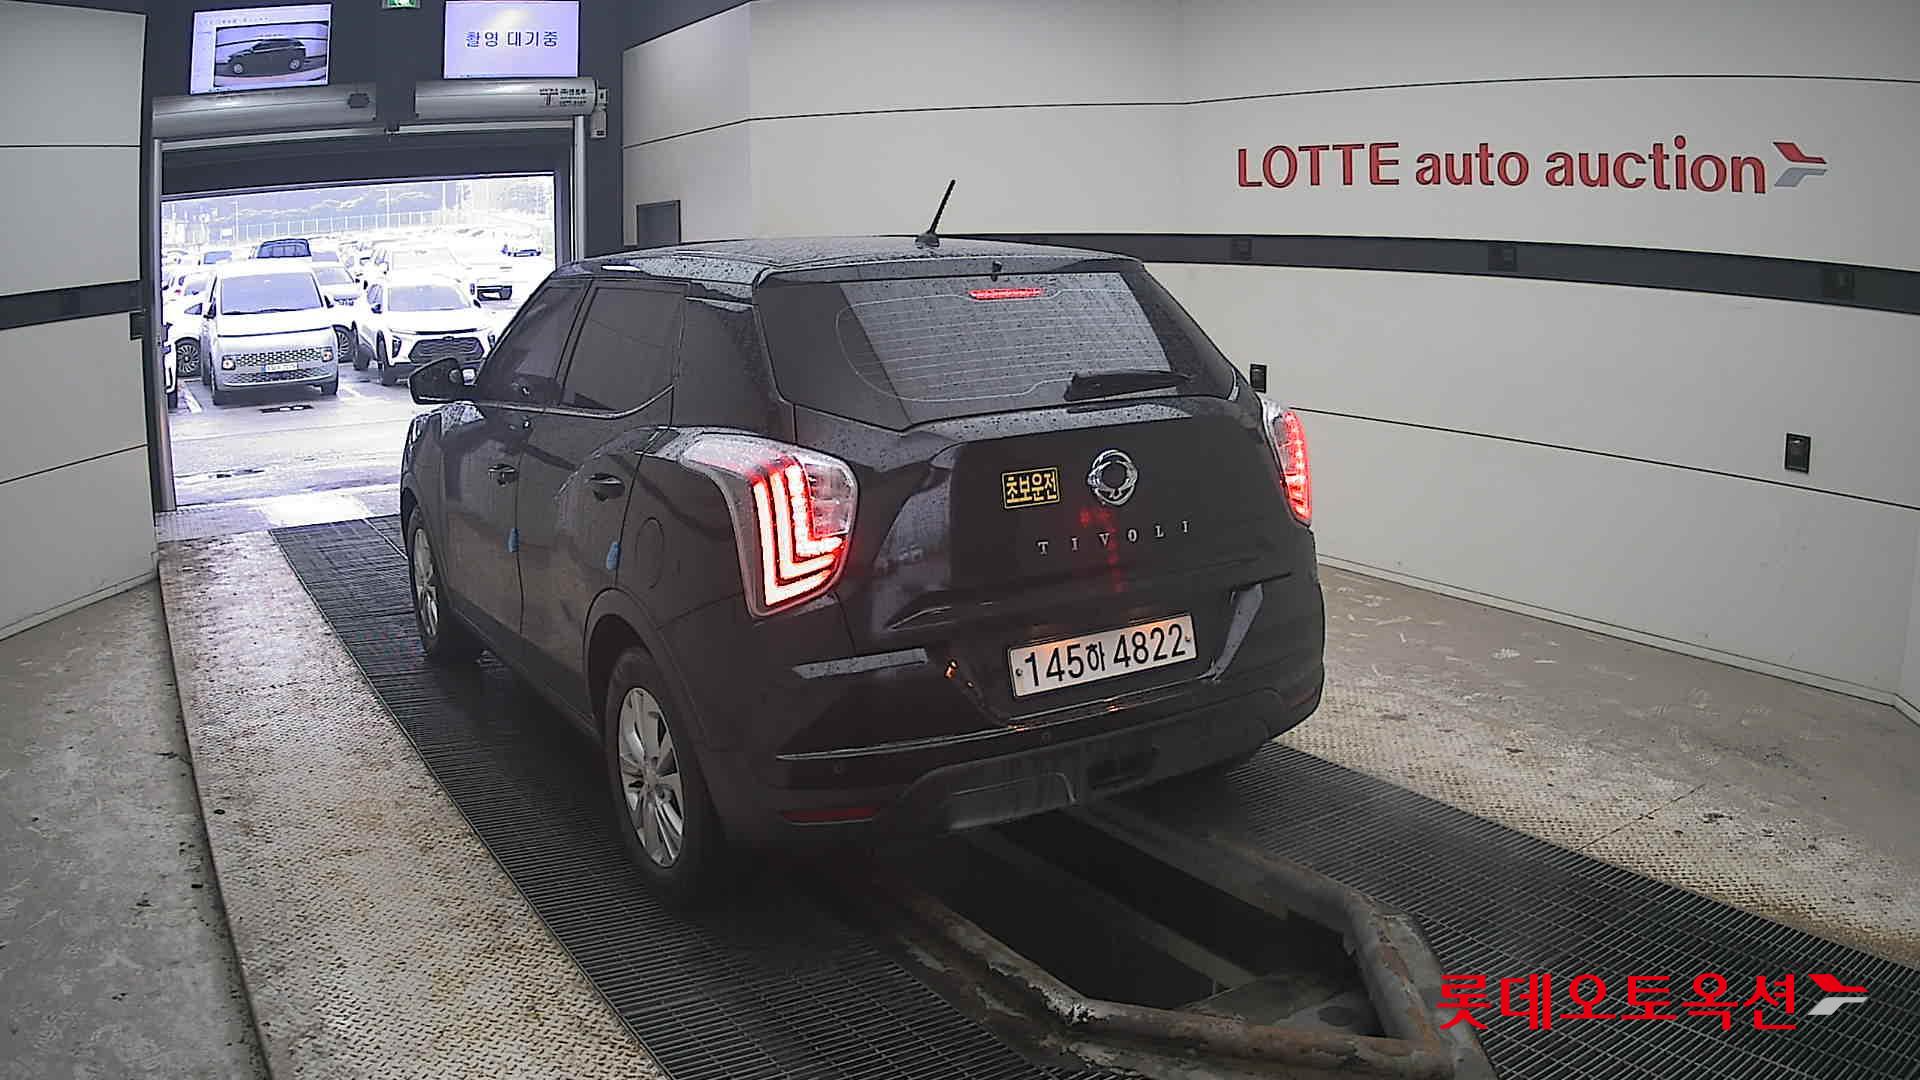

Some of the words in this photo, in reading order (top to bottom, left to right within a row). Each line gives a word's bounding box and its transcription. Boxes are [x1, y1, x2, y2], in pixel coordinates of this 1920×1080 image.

[507, 31, 558, 47] 대기중
[1237, 142, 1400, 188] LOTTE
[1415, 142, 1530, 187] auto
[1544, 135, 1768, 194] auction
[1006, 471, 1057, 503] 초보운전
[1037, 520, 1189, 555] TIVOLI
[1025, 641, 1105, 687] 145하
[1113, 623, 1186, 668] 4822
